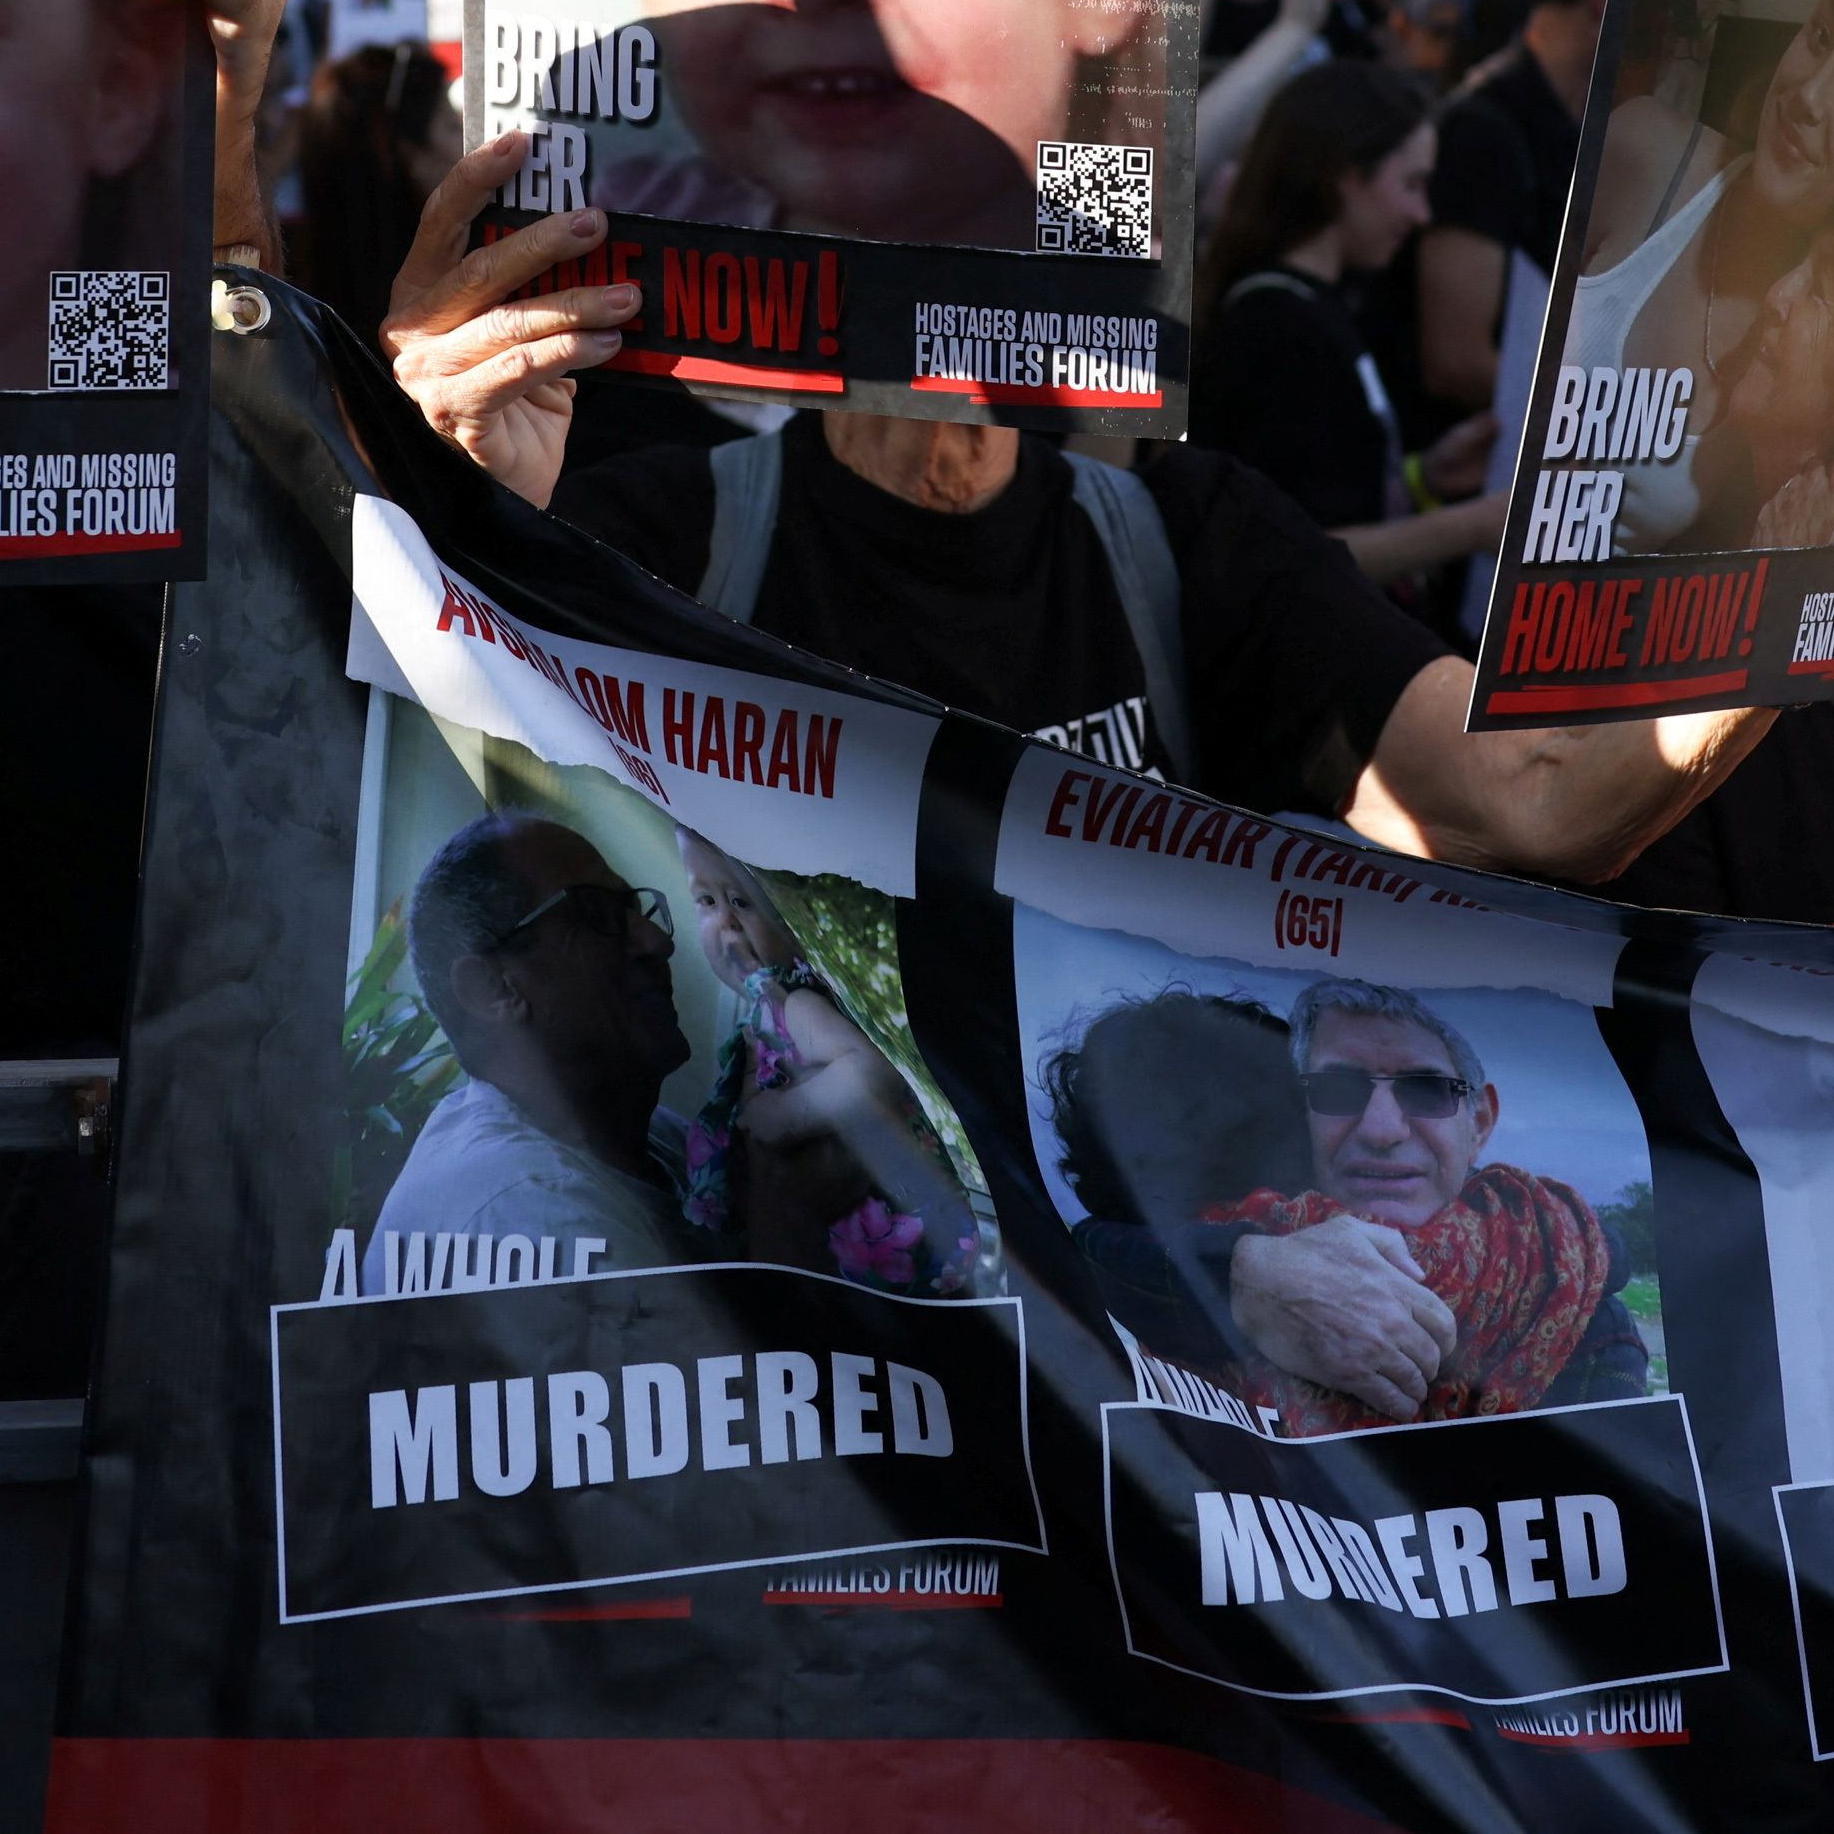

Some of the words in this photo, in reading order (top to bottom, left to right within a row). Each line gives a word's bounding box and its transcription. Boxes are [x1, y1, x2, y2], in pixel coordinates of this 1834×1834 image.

[489, 22, 657, 121] BRING
[664, 249, 840, 358] NOW!
[915, 302, 1018, 343] HOSTAGES
[1021, 310, 1061, 344] AND
[1065, 313, 1158, 350] MISSING
[915, 335, 1045, 388] FAMILIES
[1051, 346, 1158, 395] FORUM
[1542, 367, 1694, 461] BRING
[32, 454, 77, 490] AND
[81, 452, 176, 489] MISSING
[65, 487, 176, 537] FORUM
[1523, 470, 1624, 564] HER
[1500, 577, 1641, 676] HOME
[1640, 559, 1767, 666] NOW!
[663, 688, 844, 799] HARAN
[1045, 769, 1272, 869] EVIATAR
[1274, 889, 1342, 957] (65)
[319, 1229, 358, 1302] A
[369, 1351, 954, 1510] MURDERED
[898, 1556, 999, 1597] FORUM
[1194, 1492, 1627, 1619] MURDERED
[1584, 1688, 1683, 1736] FORUM
